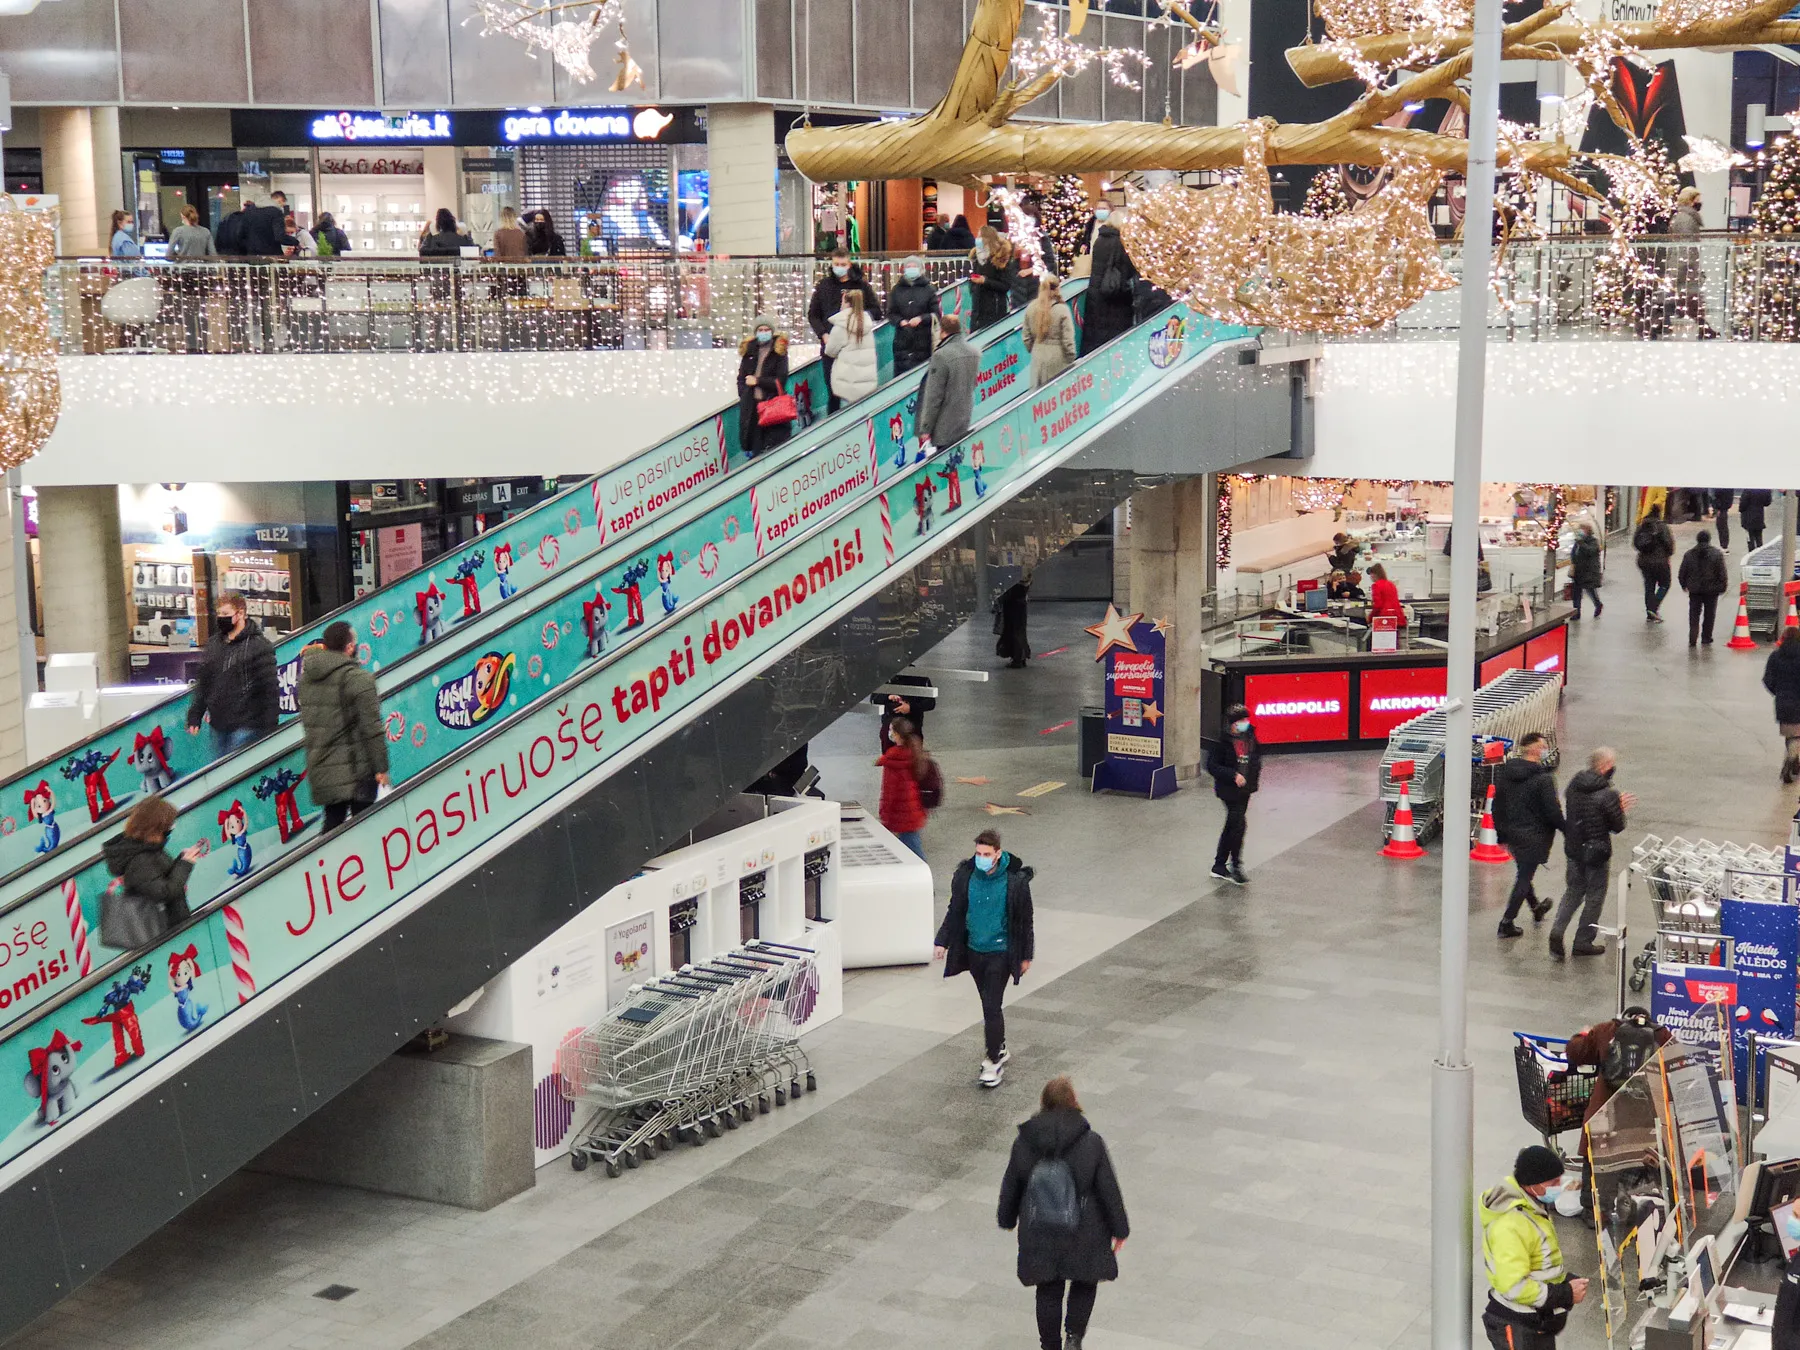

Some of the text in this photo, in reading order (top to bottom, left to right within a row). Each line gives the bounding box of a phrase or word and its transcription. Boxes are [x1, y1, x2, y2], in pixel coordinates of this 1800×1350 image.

[504, 110, 629, 141] gera dovana
[994, 353, 1018, 374] rasite
[980, 371, 1017, 401] 3 aukšte
[1032, 373, 1093, 423] Mus rasite
[1040, 400, 1090, 444] 3 aukšte
[609, 435, 710, 505] Jie pasiruošę
[766, 442, 861, 512] Jie pasiruošę
[516, 486, 529, 496] EXIT
[610, 457, 719, 534] tapti dovanomis!
[766, 464, 869, 541] tapti dovanomis!
[256, 526, 289, 542] TELE2
[1255, 700, 1340, 716] AKROPOLIS
[286, 528, 864, 936] Jie pasiruošę tapti dovanomis!
[618, 919, 647, 939] Yogoland
